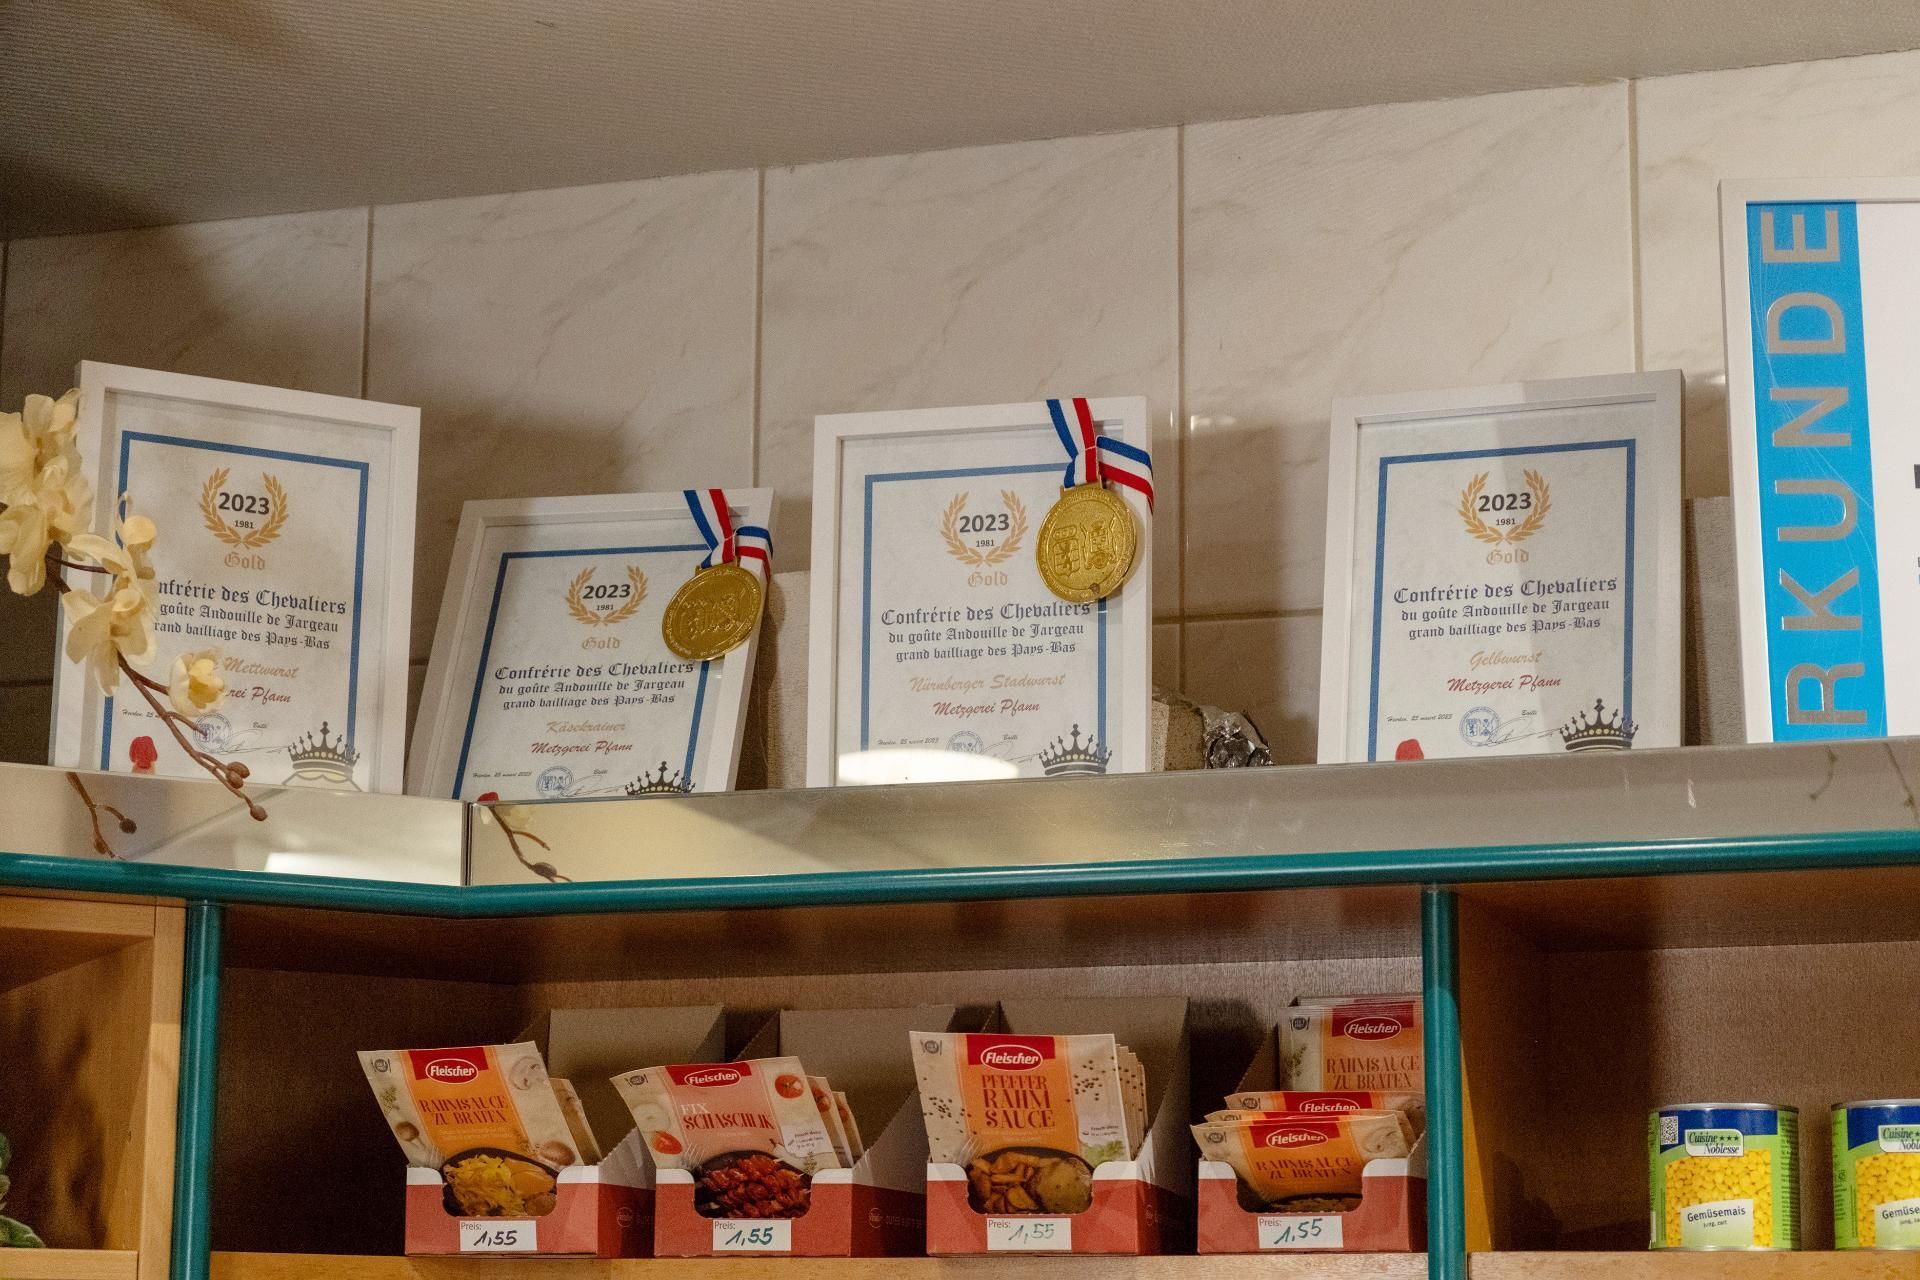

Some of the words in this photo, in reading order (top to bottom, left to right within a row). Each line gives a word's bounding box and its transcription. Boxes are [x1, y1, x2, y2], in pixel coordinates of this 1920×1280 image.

[1761, 208, 1867, 724] RKUNDE
[218, 492, 270, 515] 2023
[1478, 493, 1532, 512] 2023
[235, 520, 254, 529] 1981
[959, 513, 1010, 533] 2023
[1496, 518, 1516, 526] 1981
[224, 552, 265, 570] Gold
[1486, 549, 1529, 565] Gold
[968, 571, 1008, 588] Gold
[159, 580, 216, 599] nfrérie
[221, 586, 249, 603] des
[256, 589, 346, 614] Chevaliers
[583, 584, 631, 600] 2023
[1394, 584, 1478, 603] Confrérie
[1485, 584, 1513, 598] des
[1521, 577, 1617, 597] Chevaliers
[200, 605, 262, 624] Andouille
[267, 613, 281, 626] de
[284, 614, 339, 632] Jargeau
[881, 607, 960, 626] Confrérie
[967, 607, 993, 621] des
[1001, 601, 1091, 620] Chevaliers
[1401, 610, 1417, 621] du
[1463, 605, 1528, 617] Andouille
[1532, 603, 1547, 613] de
[1552, 600, 1609, 614] Jargeau
[154, 621, 181, 633] rand
[241, 629, 260, 642] des
[889, 632, 904, 643] du
[946, 627, 1007, 641] Andouille
[1012, 626, 1025, 637] de
[1029, 624, 1084, 638] Jargeau
[1409, 626, 1444, 640] grand
[1506, 622, 1526, 632] des
[582, 637, 620, 650] Gold
[896, 649, 930, 663] grand
[988, 646, 1007, 656] des
[1470, 651, 1542, 671] Gelbwurst
[223, 657, 299, 678] Mettwurst
[495, 665, 571, 680] Confrérie
[576, 665, 602, 677] des
[609, 661, 694, 677] Chevaliers
[499, 686, 513, 694] du
[554, 681, 612, 694] Andouille
[617, 681, 629, 690] de
[633, 679, 685, 692] Jargeau
[910, 676, 984, 694] Nürnberger
[990, 673, 1066, 689] Stadwurst
[1447, 678, 1514, 694] Metzgerei
[1519, 675, 1562, 692] Pfann
[252, 687, 291, 704] Pfann
[503, 699, 535, 711] grand
[591, 696, 609, 705] des
[933, 702, 995, 718] Metzgerei
[1000, 699, 1040, 716] Pfann
[546, 720, 626, 733] Käsekrainer
[531, 742, 591, 757] Metzgerei
[595, 740, 633, 755] Pfann
[1348, 1024, 1398, 1034] Fleischer
[985, 1053, 1039, 1065] Fleischer
[1327, 1055, 1420, 1074] RAHMSAUCE
[430, 1065, 475, 1077] Fleischer
[689, 1071, 737, 1085] Fleischer
[982, 1074, 1047, 1089] PFEFFER
[1334, 1073, 1350, 1090] ZU
[1357, 1073, 1413, 1089] BRATEN
[420, 1095, 508, 1114] RAHMSAUCE
[984, 1089, 1051, 1109] RAHM
[680, 1103, 712, 1114] FIX
[1304, 1104, 1357, 1112] Fleischer
[432, 1110, 449, 1125] ZU
[455, 1109, 507, 1124] BRATEN
[683, 1112, 775, 1131] SCHASCHLIK
[986, 1110, 1055, 1128] SAUCE
[1272, 1131, 1324, 1144] Fleischer
[1689, 1132, 1718, 1143] Cuisine
[1883, 1128, 1913, 1139] Cuisine
[1704, 1144, 1740, 1154] Noblesse
[1900, 1140, 1920, 1150] Nobl
[1257, 1157, 1357, 1171] RAHMSAUCE
[1270, 1168, 1285, 1179] ZU
[1293, 1167, 1352, 1179] BRATEN
[1688, 1206, 1746, 1222] Gemüsemais
[1882, 1206, 1920, 1219] Gemüse
[461, 1222, 481, 1230] Preis:
[715, 1221, 735, 1229] Preis:
[989, 1220, 1011, 1228] Preis:
[474, 1230, 517, 1246] 1,55
[725, 1227, 773, 1246] 1,55
[1008, 1224, 1054, 1244] 1,55
